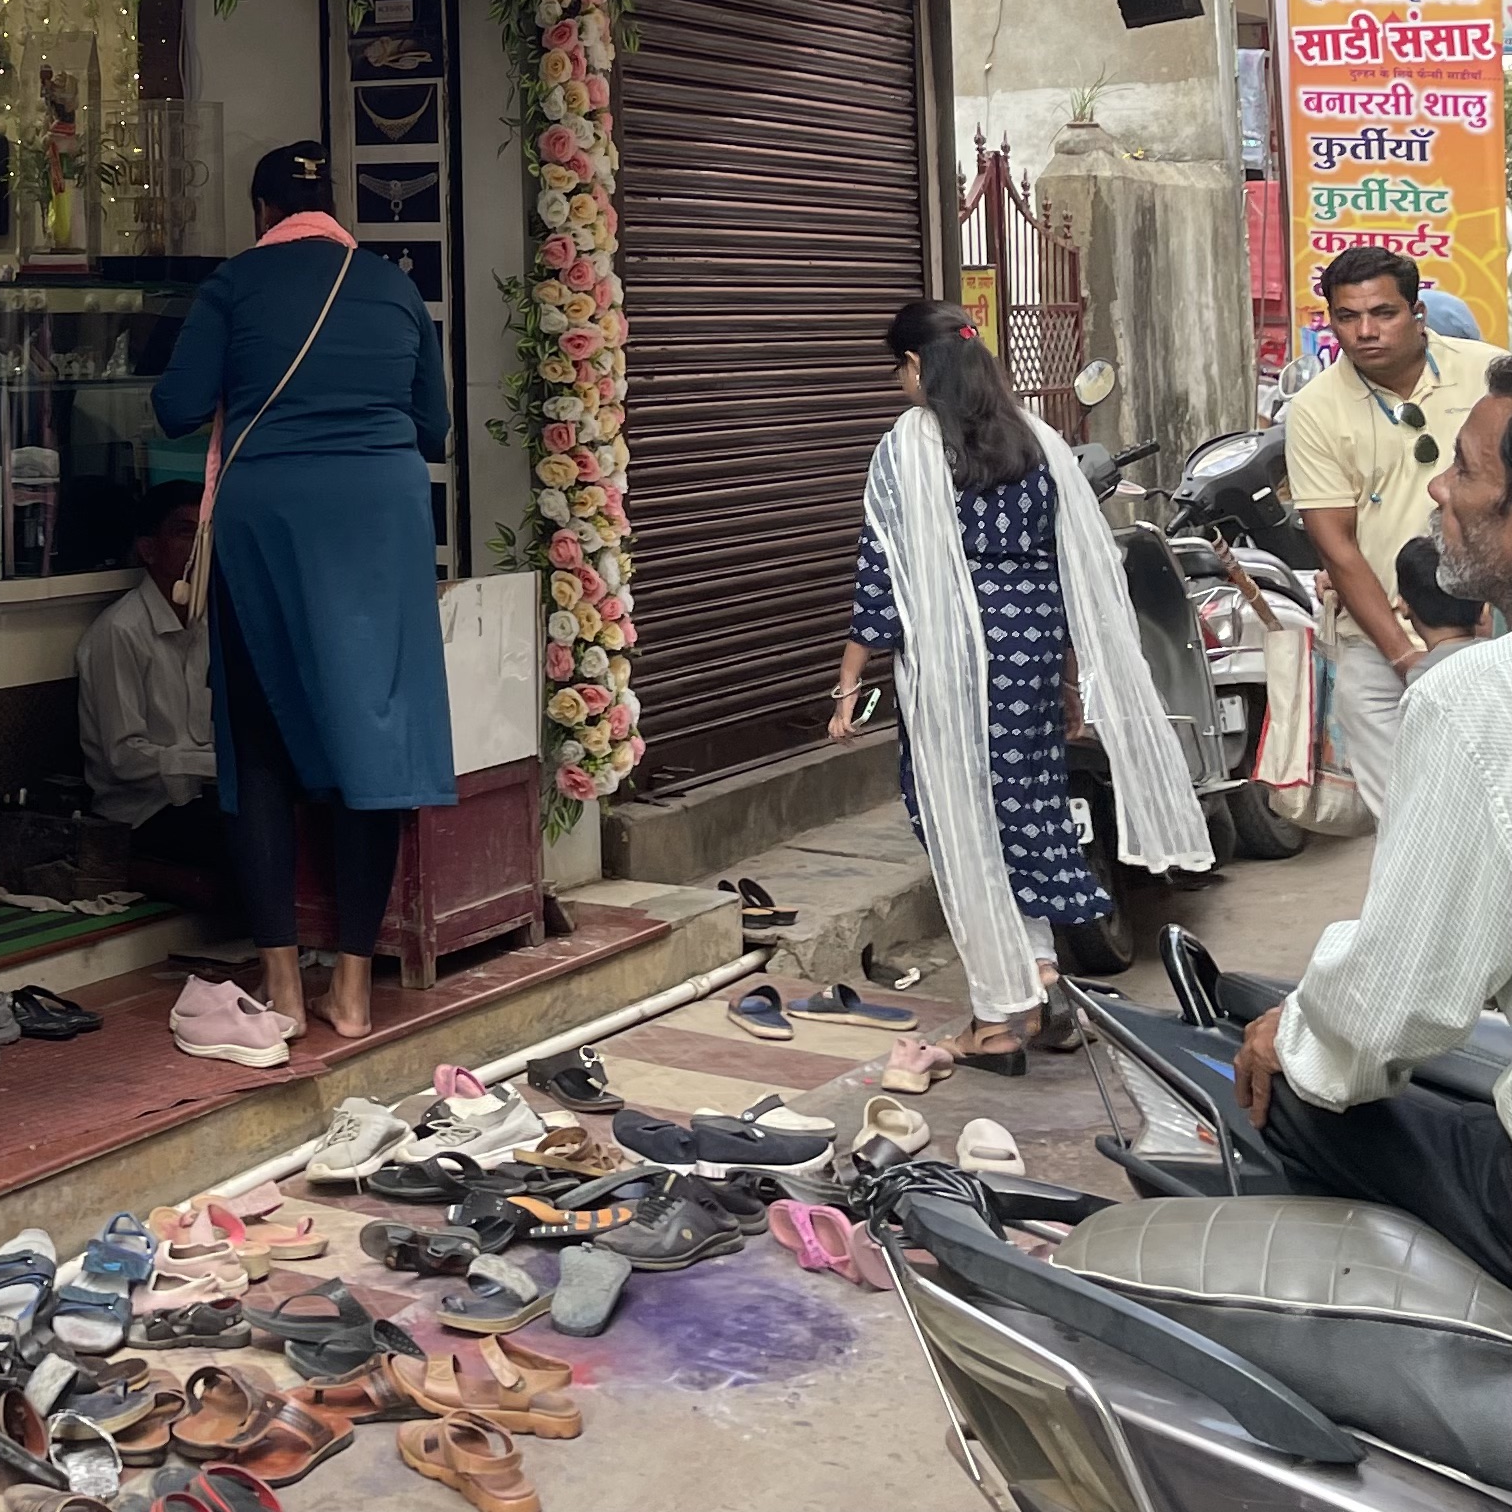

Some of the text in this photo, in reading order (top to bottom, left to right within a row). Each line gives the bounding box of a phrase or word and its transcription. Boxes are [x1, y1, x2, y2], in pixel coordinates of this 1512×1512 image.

[1294, 10, 1493, 62] साडी संसार
[1302, 82, 1487, 129] बनारसी शालु
[1310, 127, 1435, 170] कुर्तीयाँ
[1311, 177, 1449, 220] कुर्तीसेट
